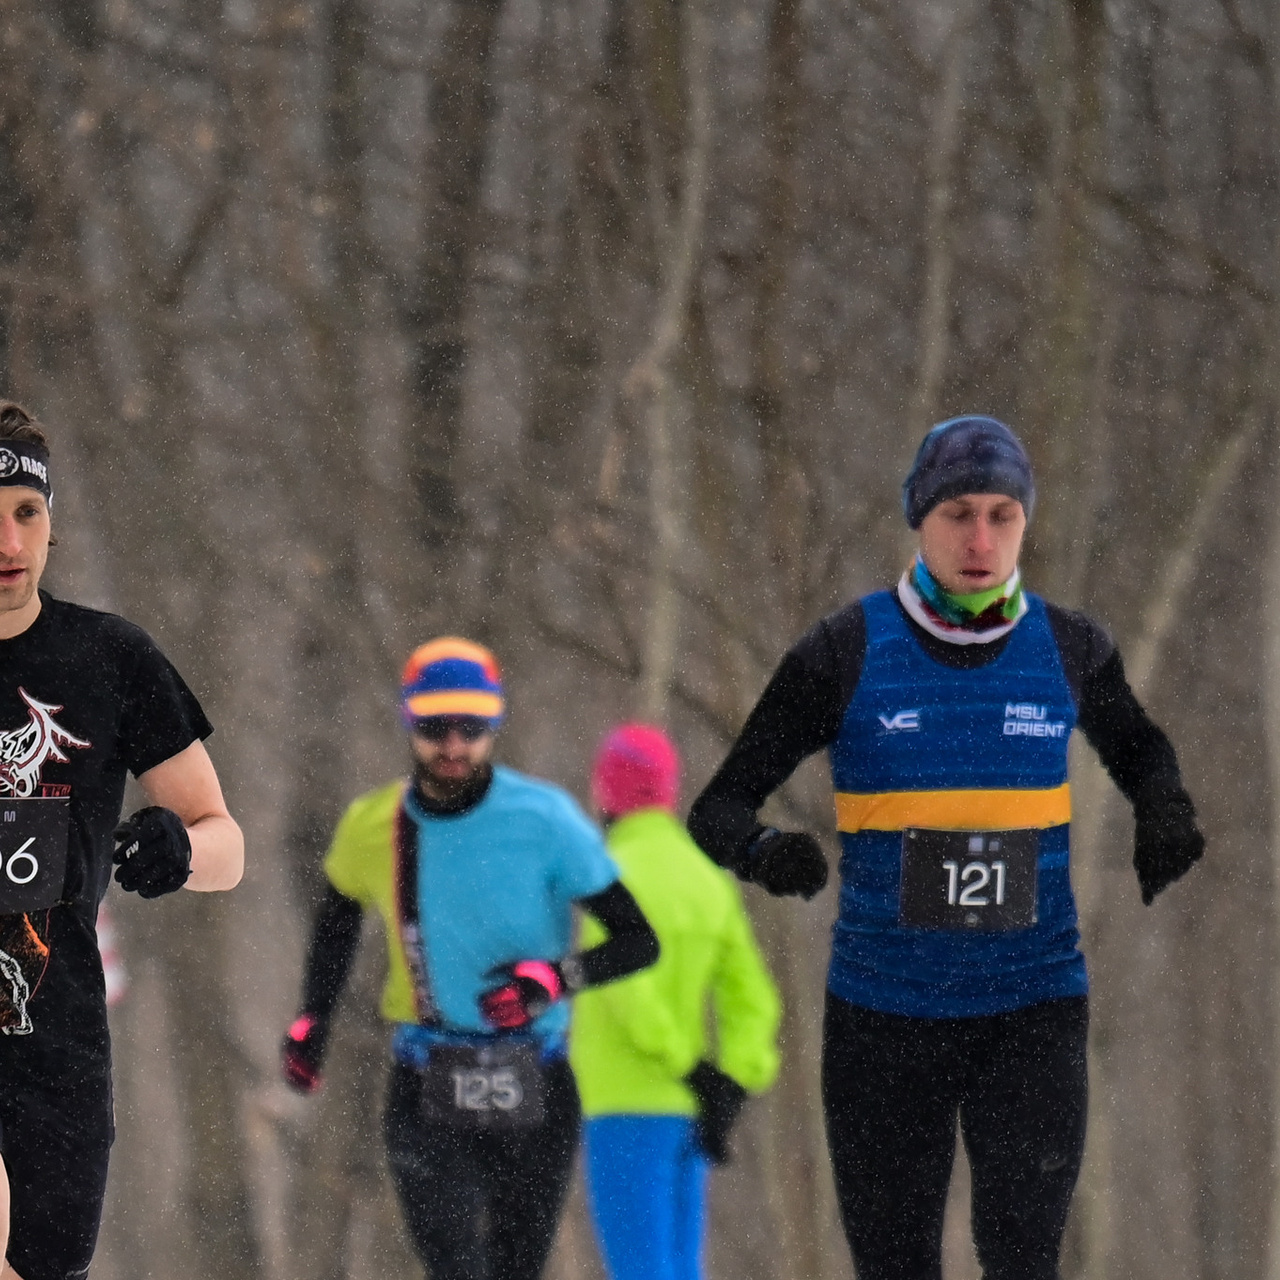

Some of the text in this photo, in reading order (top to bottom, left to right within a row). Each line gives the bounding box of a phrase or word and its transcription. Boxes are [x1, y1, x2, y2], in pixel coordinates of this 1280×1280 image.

[1005, 702, 1046, 720] MSU
[1003, 721, 1066, 738] ORIENT
[943, 860, 1006, 906] 121
[451, 1067, 523, 1111] 125
